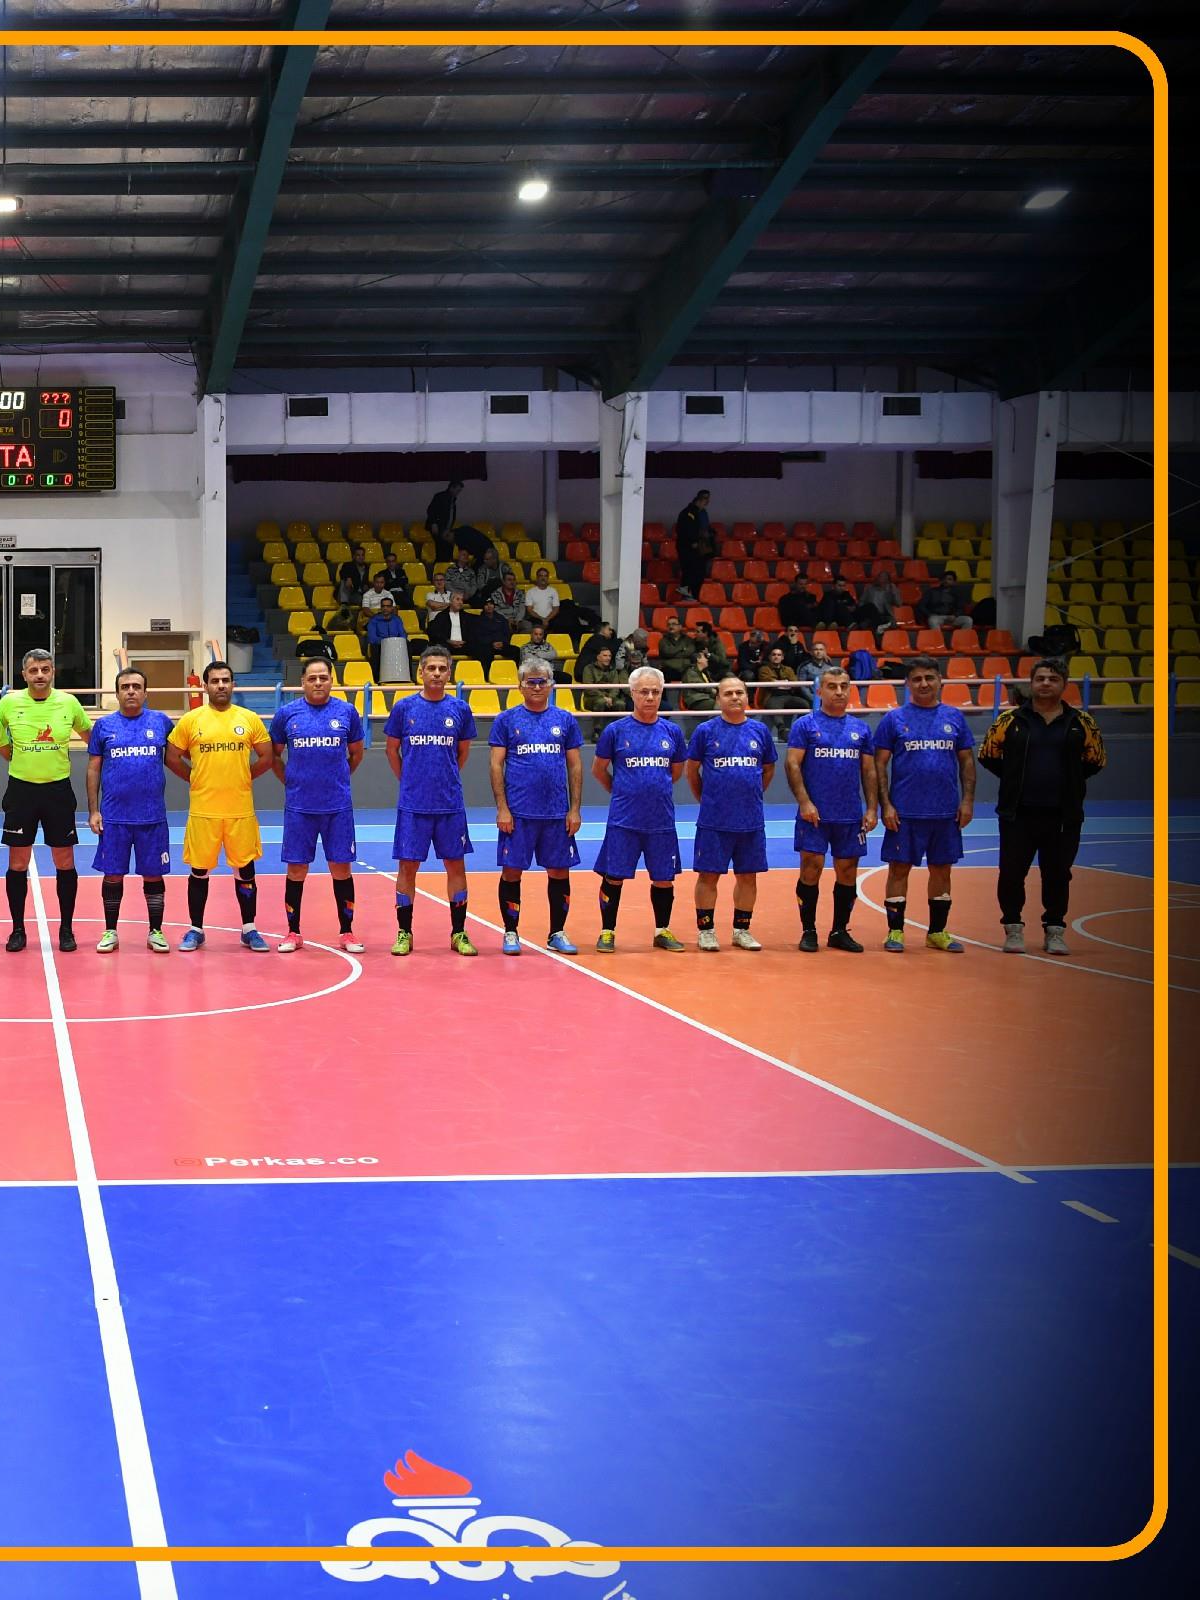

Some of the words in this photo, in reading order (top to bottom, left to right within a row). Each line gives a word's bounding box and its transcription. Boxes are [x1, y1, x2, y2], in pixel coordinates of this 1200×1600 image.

[41, 392, 70, 404] ???
[58, 410, 71, 427] 0
[110, 746, 156, 758] BSH.PIHO.IR
[199, 742, 244, 753] BSH.PIHO.IR
[160, 852, 170, 865] 10
[204, 1156, 380, 1167] Perkas.co
